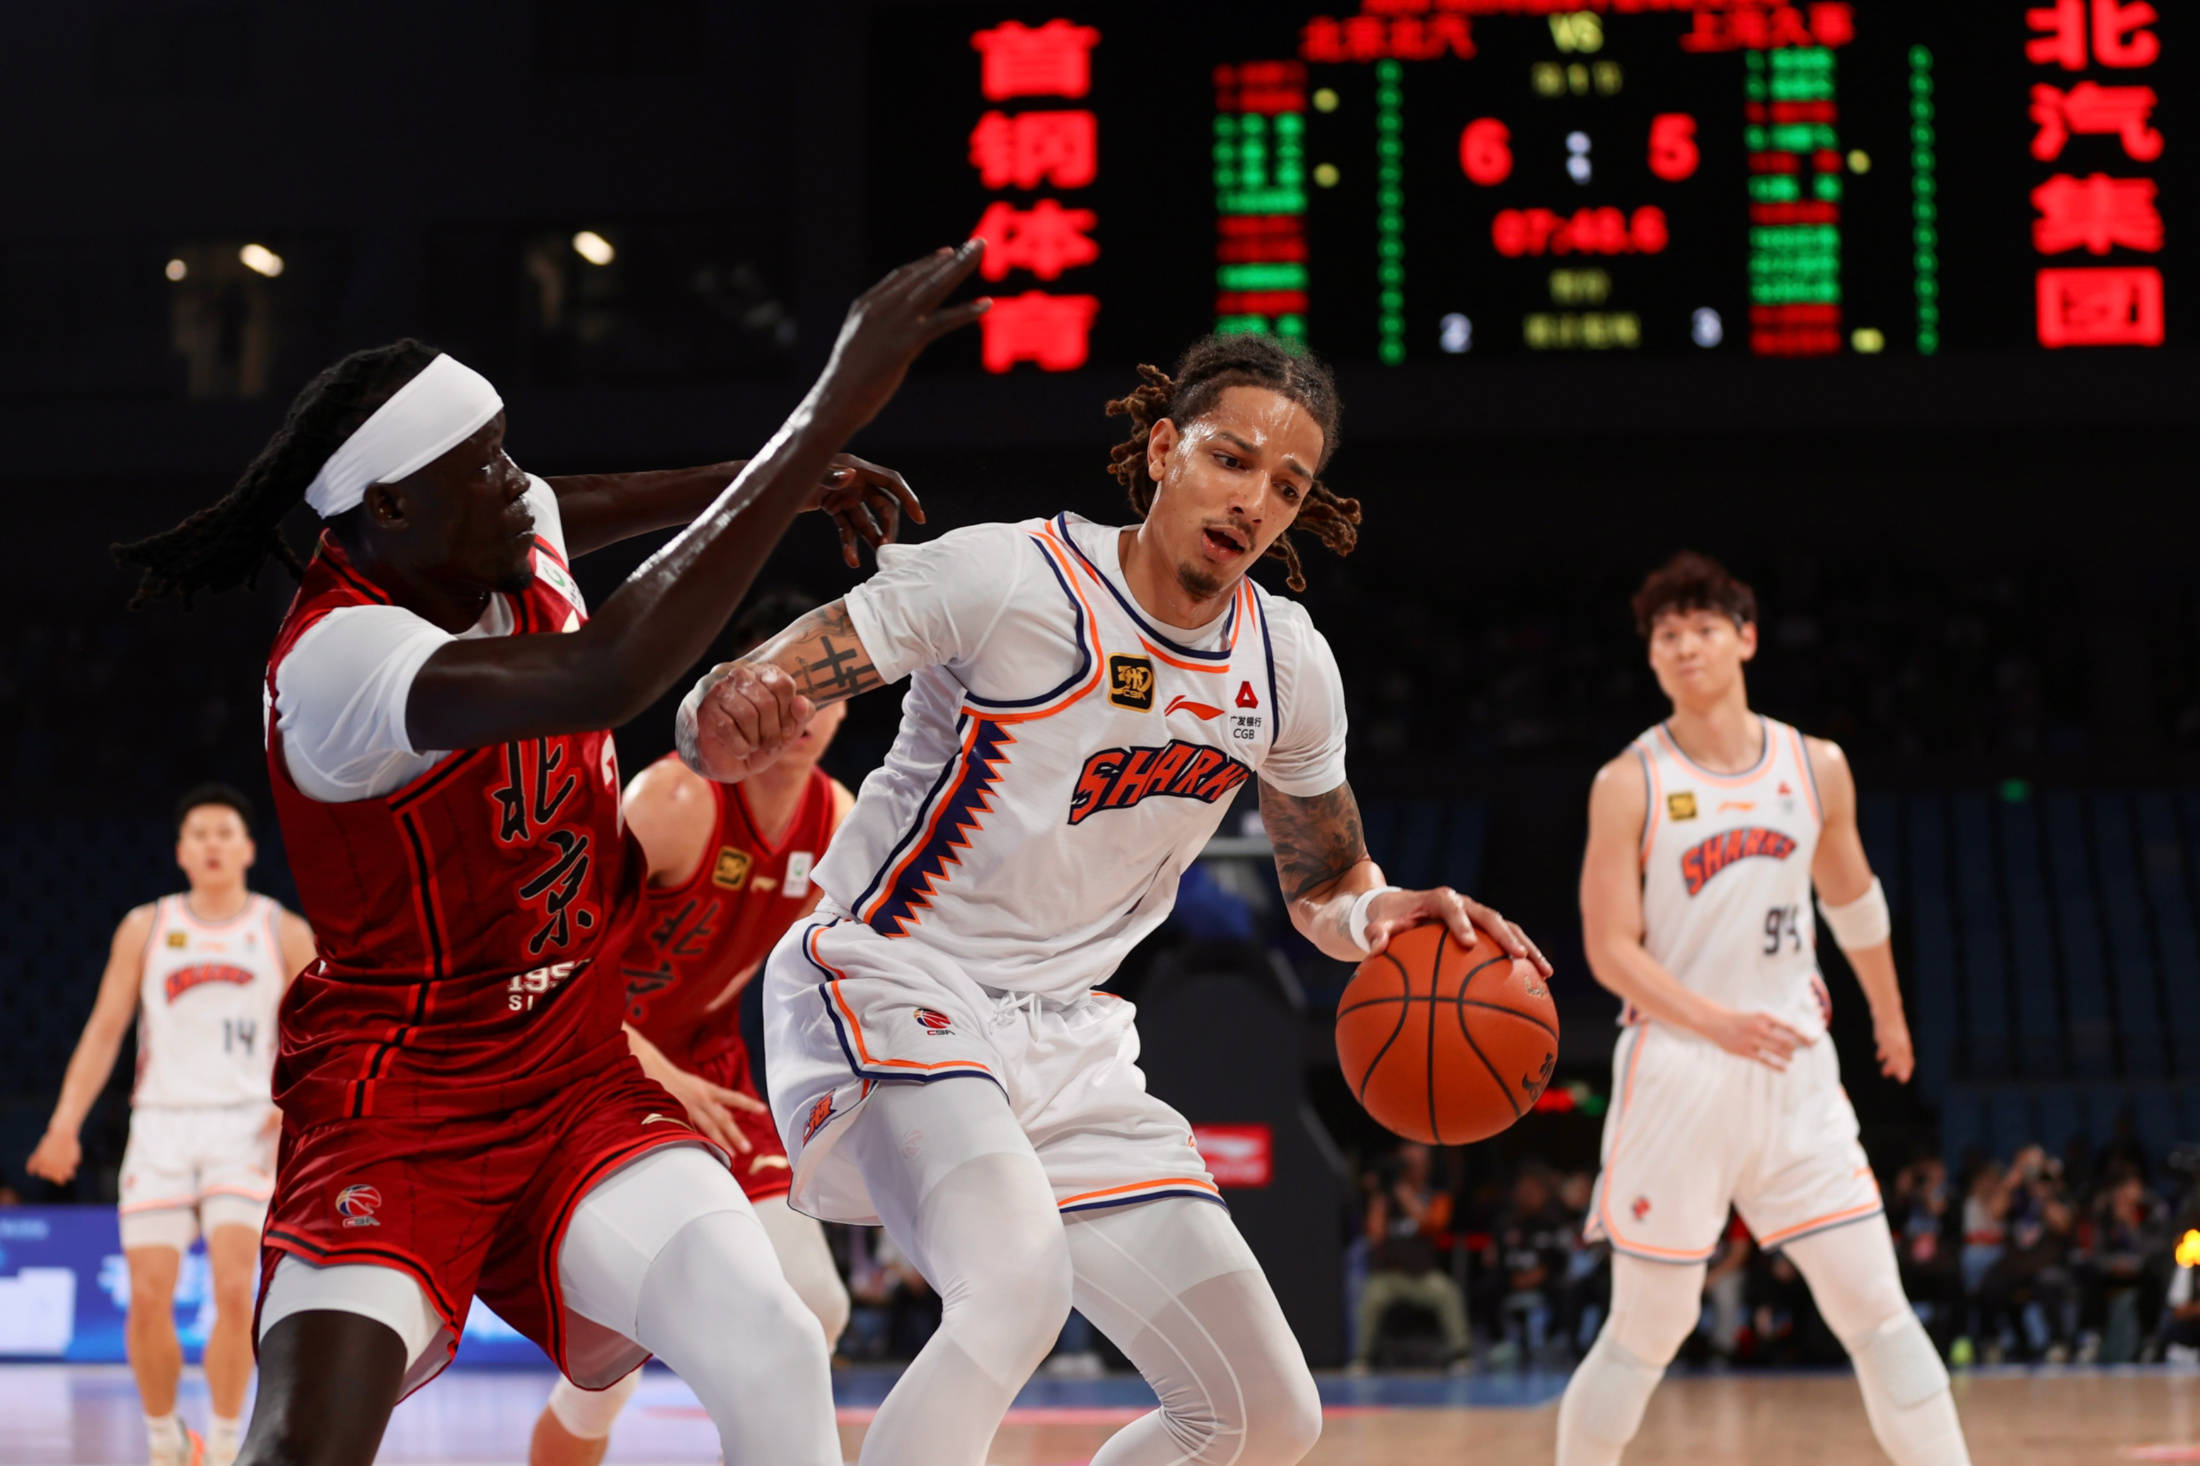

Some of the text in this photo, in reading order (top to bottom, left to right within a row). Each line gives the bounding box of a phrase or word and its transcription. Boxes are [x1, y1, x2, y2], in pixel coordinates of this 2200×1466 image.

[1549, 11, 1604, 54] VS
[1458, 117, 1513, 186] 6
[1647, 112, 1699, 181] 5
[2025, 0, 2165, 349] 北汽集团
[969, 18, 1101, 374] 首钢体育
[1233, 728, 1255, 740] CGB
[492, 734, 594, 956] 北京
[1681, 825, 1798, 898] SHARKS
[1763, 905, 1802, 957] 94
[507, 958, 592, 993] 195
[222, 1017, 256, 1056] 14
